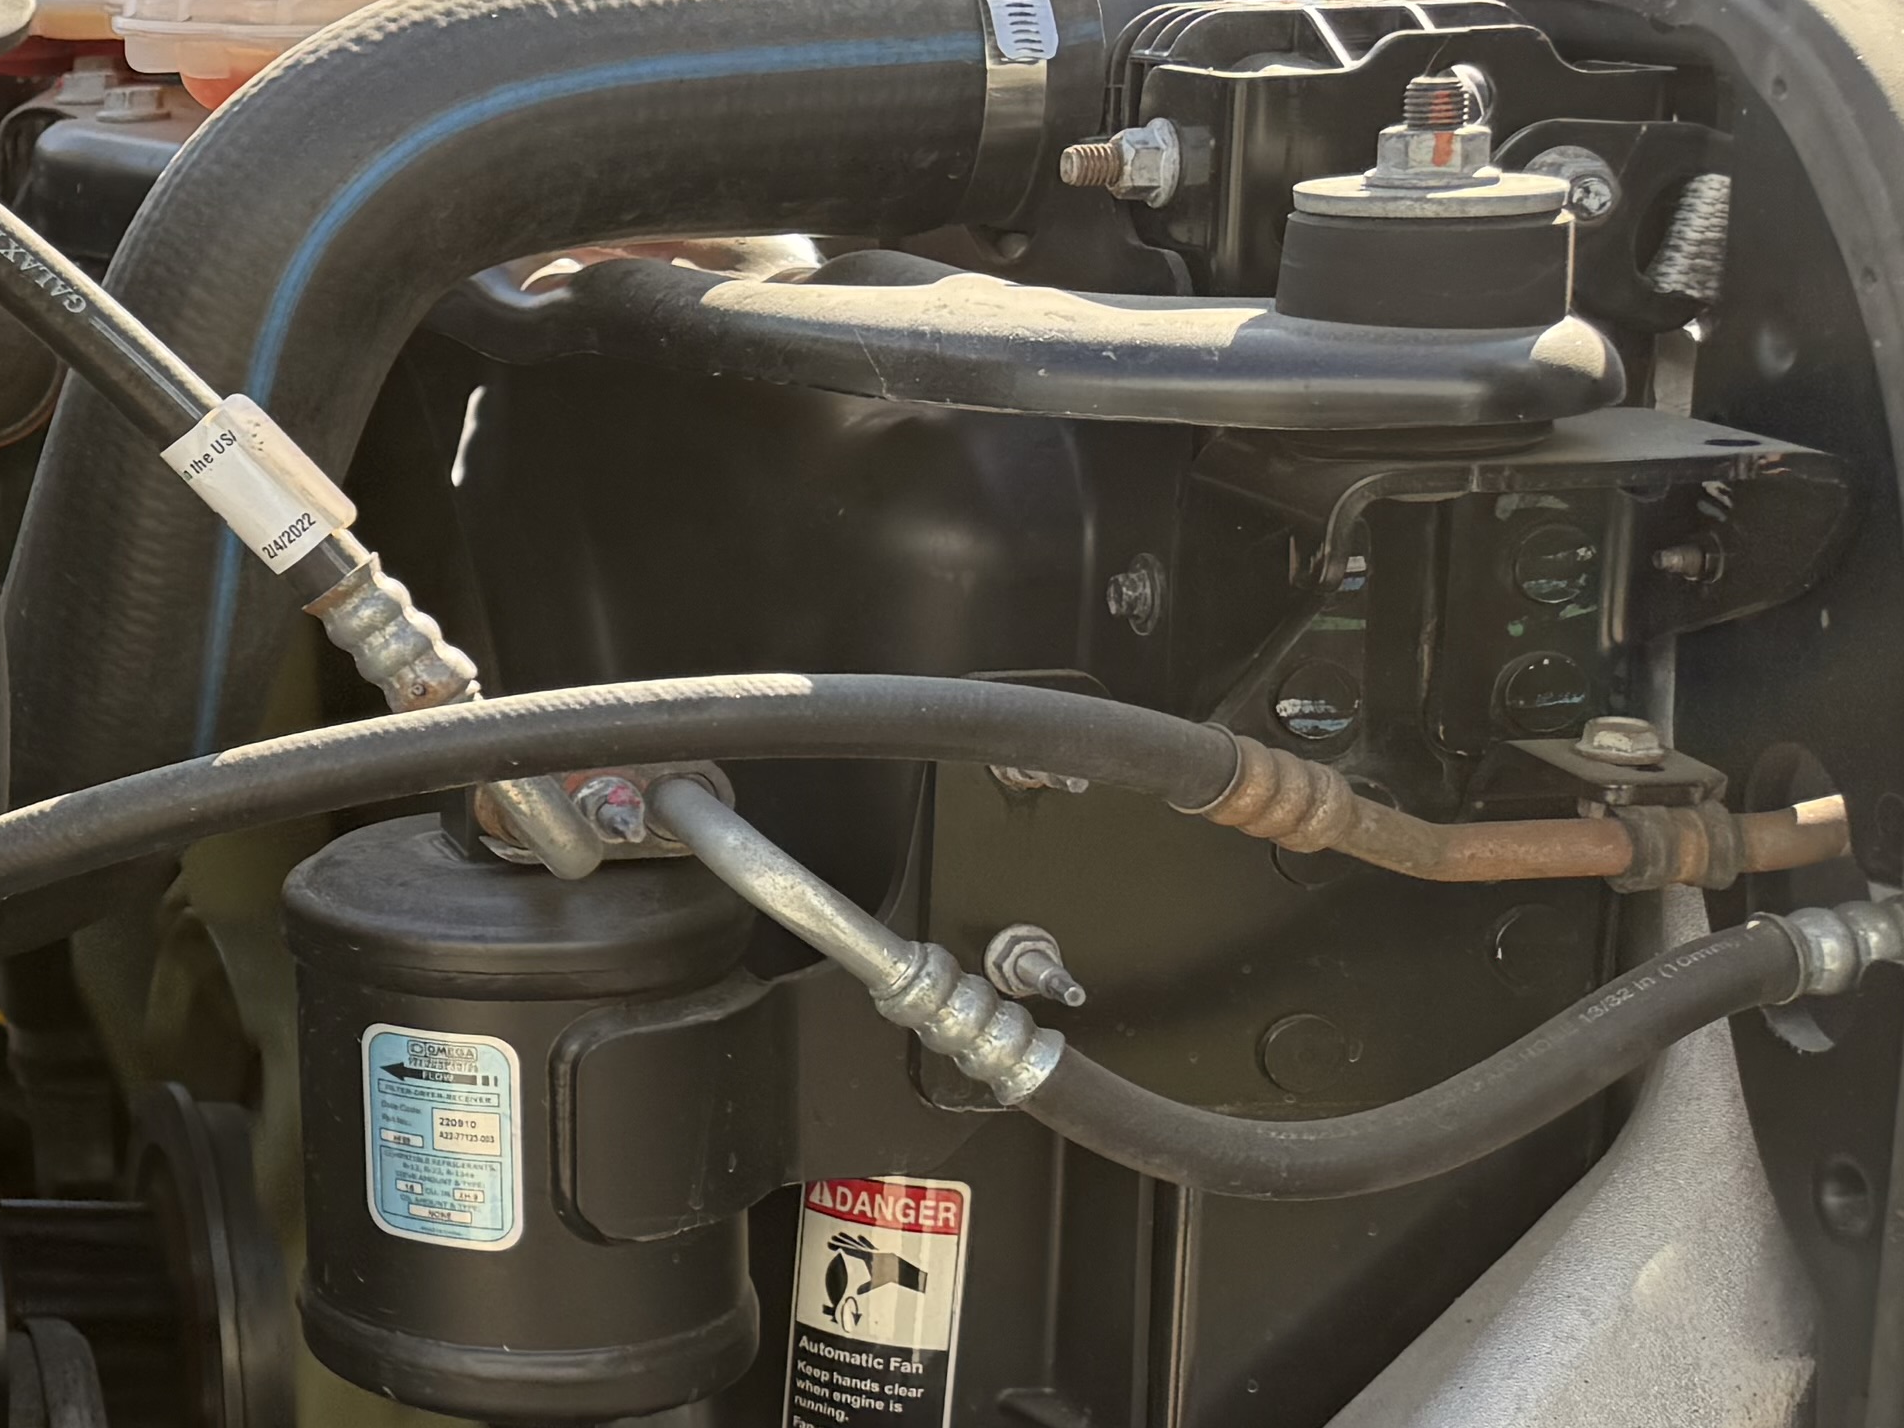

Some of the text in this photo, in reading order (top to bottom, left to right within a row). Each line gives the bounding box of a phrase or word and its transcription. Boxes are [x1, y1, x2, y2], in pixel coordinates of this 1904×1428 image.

[189, 452, 214, 475] the
[261, 512, 317, 560] 2/4/2022
[1578, 985, 1635, 1025] 13/32
[426, 1045, 476, 1059] OMEGA
[421, 1070, 455, 1082] FLOW
[835, 1185, 958, 1228] DANGER
[798, 1335, 924, 1374] Automatic Fan
[795, 1377, 904, 1413] when engine is
[796, 1359, 925, 1398] Keep hands clear
[794, 1395, 849, 1423] running.
